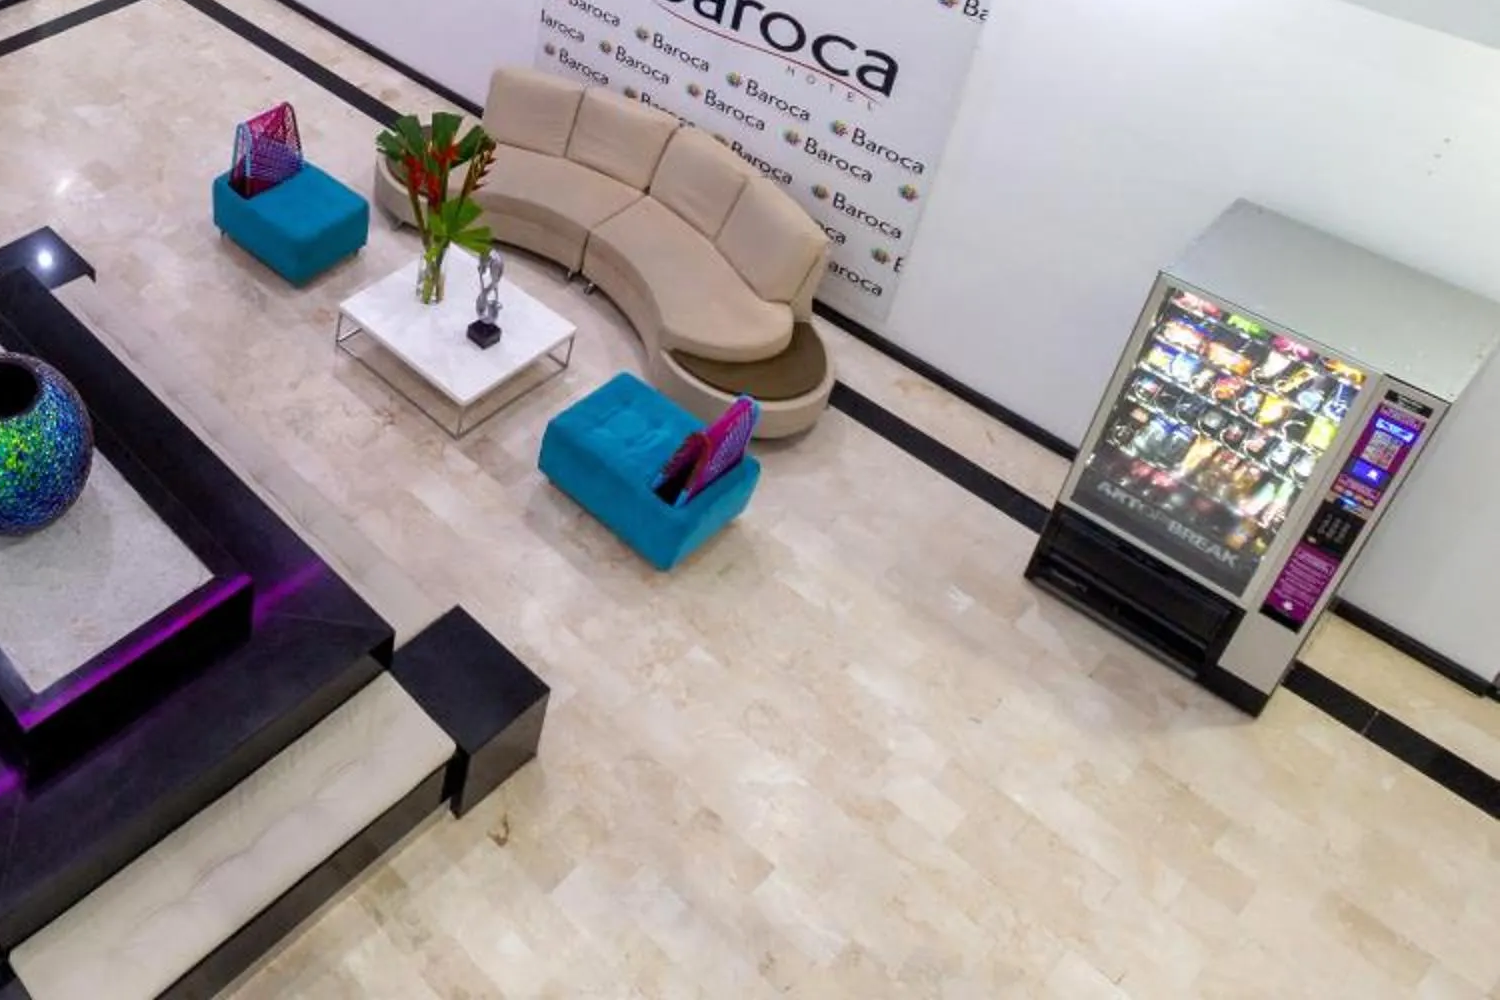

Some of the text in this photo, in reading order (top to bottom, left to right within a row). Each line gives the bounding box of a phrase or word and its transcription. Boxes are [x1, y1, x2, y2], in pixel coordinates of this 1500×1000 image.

[559, 48, 609, 85] Baroca
[833, 191, 902, 239] Baroca
[615, 45, 669, 84] Baroca
[704, 89, 765, 131] Baroca
[804, 137, 873, 182] Baroca
[653, 32, 709, 72] Baroca
[746, 79, 810, 121] Baroca
[851, 127, 925, 174] Baroca
[785, 65, 873, 111] HOTEL
